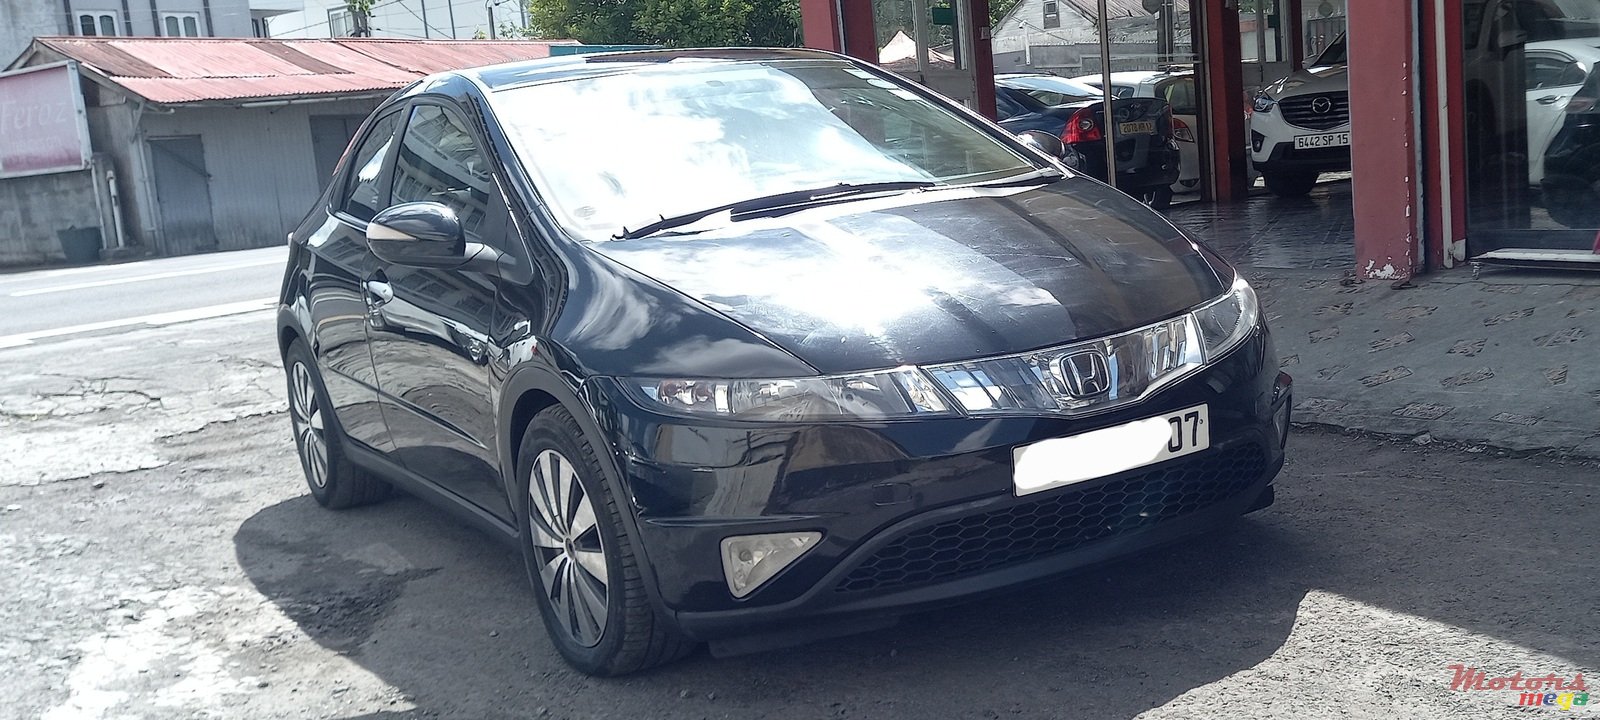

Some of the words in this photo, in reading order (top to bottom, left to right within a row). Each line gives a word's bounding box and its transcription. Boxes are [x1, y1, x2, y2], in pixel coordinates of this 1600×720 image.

[1, 100, 67, 135] Feroz
[1298, 136, 1320, 148] 6442
[1322, 135, 1334, 146] SP
[1337, 133, 1348, 145] 15
[1167, 410, 1199, 453] 07
